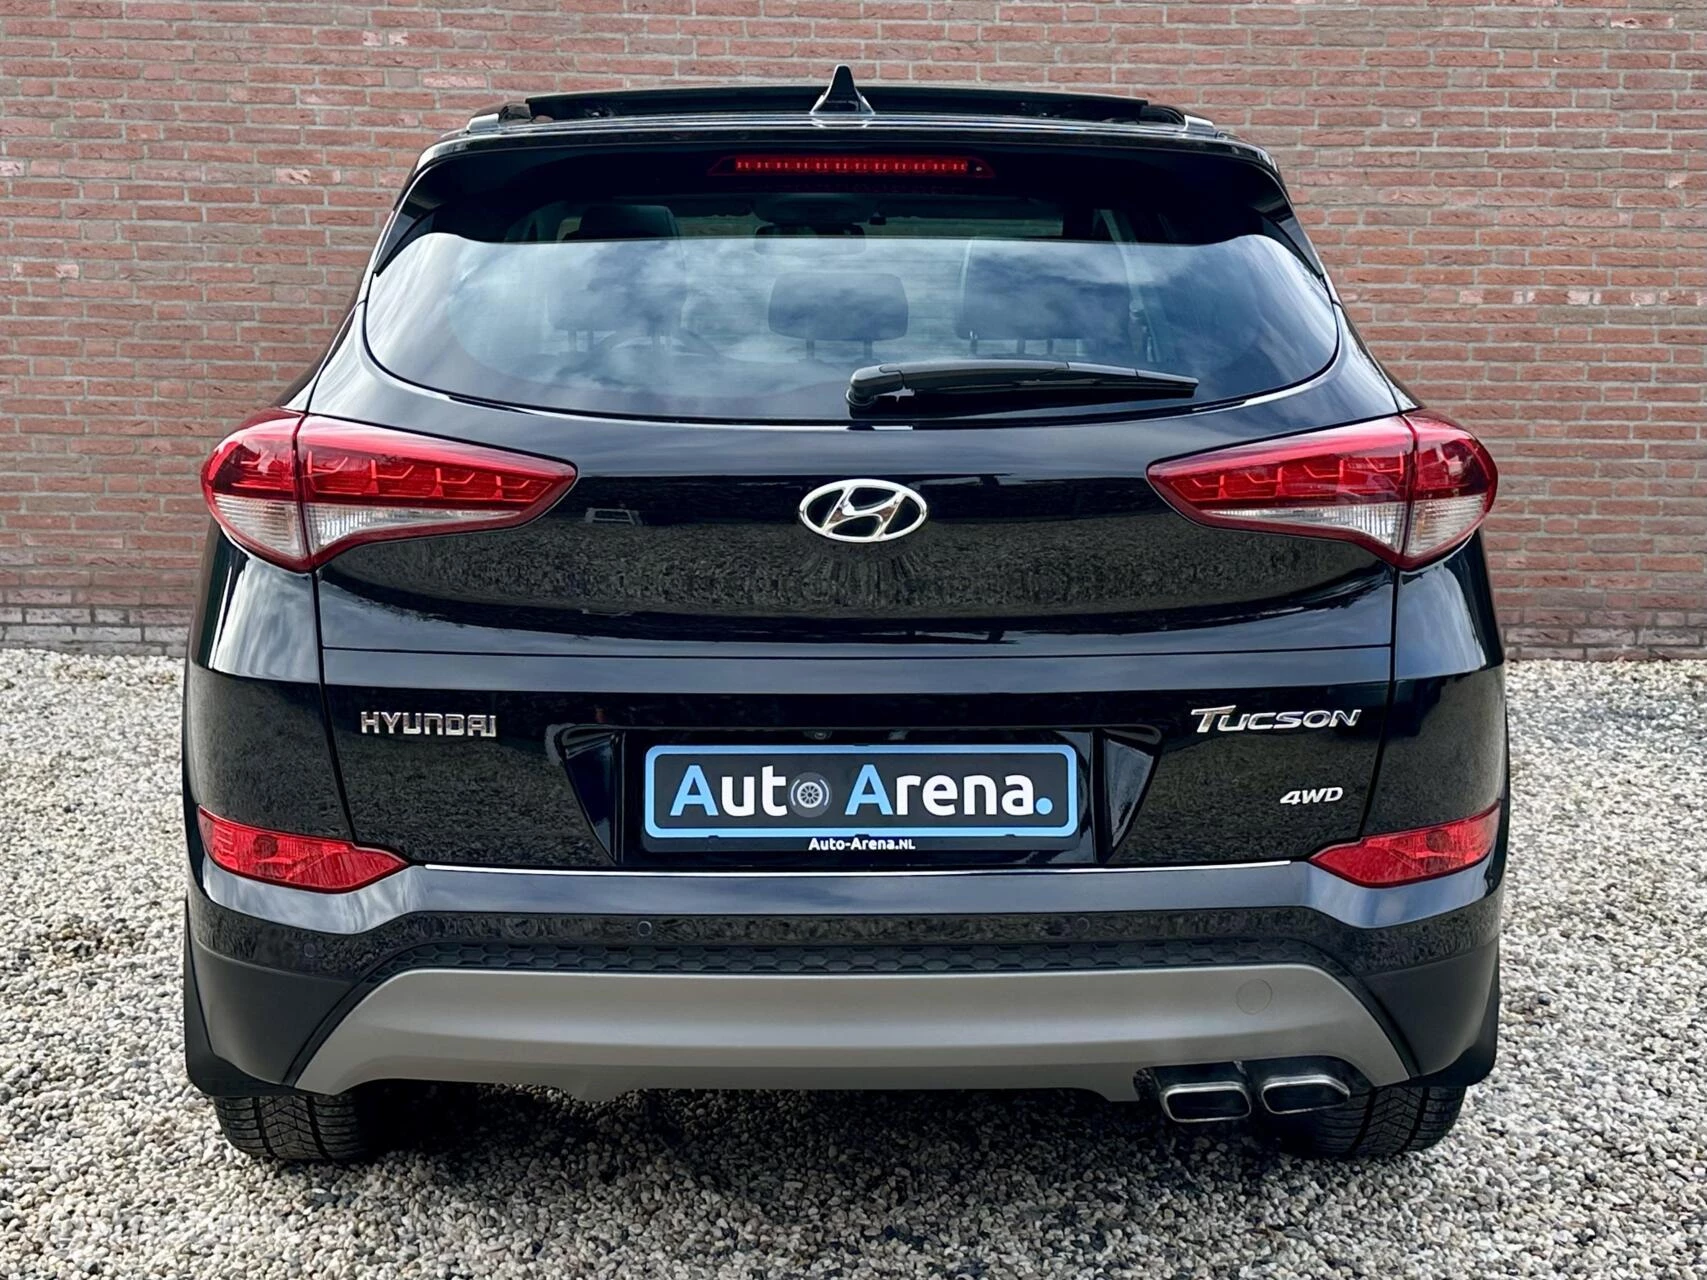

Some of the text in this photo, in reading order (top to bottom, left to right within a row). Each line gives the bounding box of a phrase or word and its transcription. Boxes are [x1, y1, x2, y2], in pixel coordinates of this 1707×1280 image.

[360, 711, 497, 738] HYUNDAI
[1190, 704, 1363, 734] TUCSON
[844, 763, 1054, 817] Arena.
[1279, 786, 1344, 805] 4WD
[808, 837, 917, 851] Auto-Arena.NL
